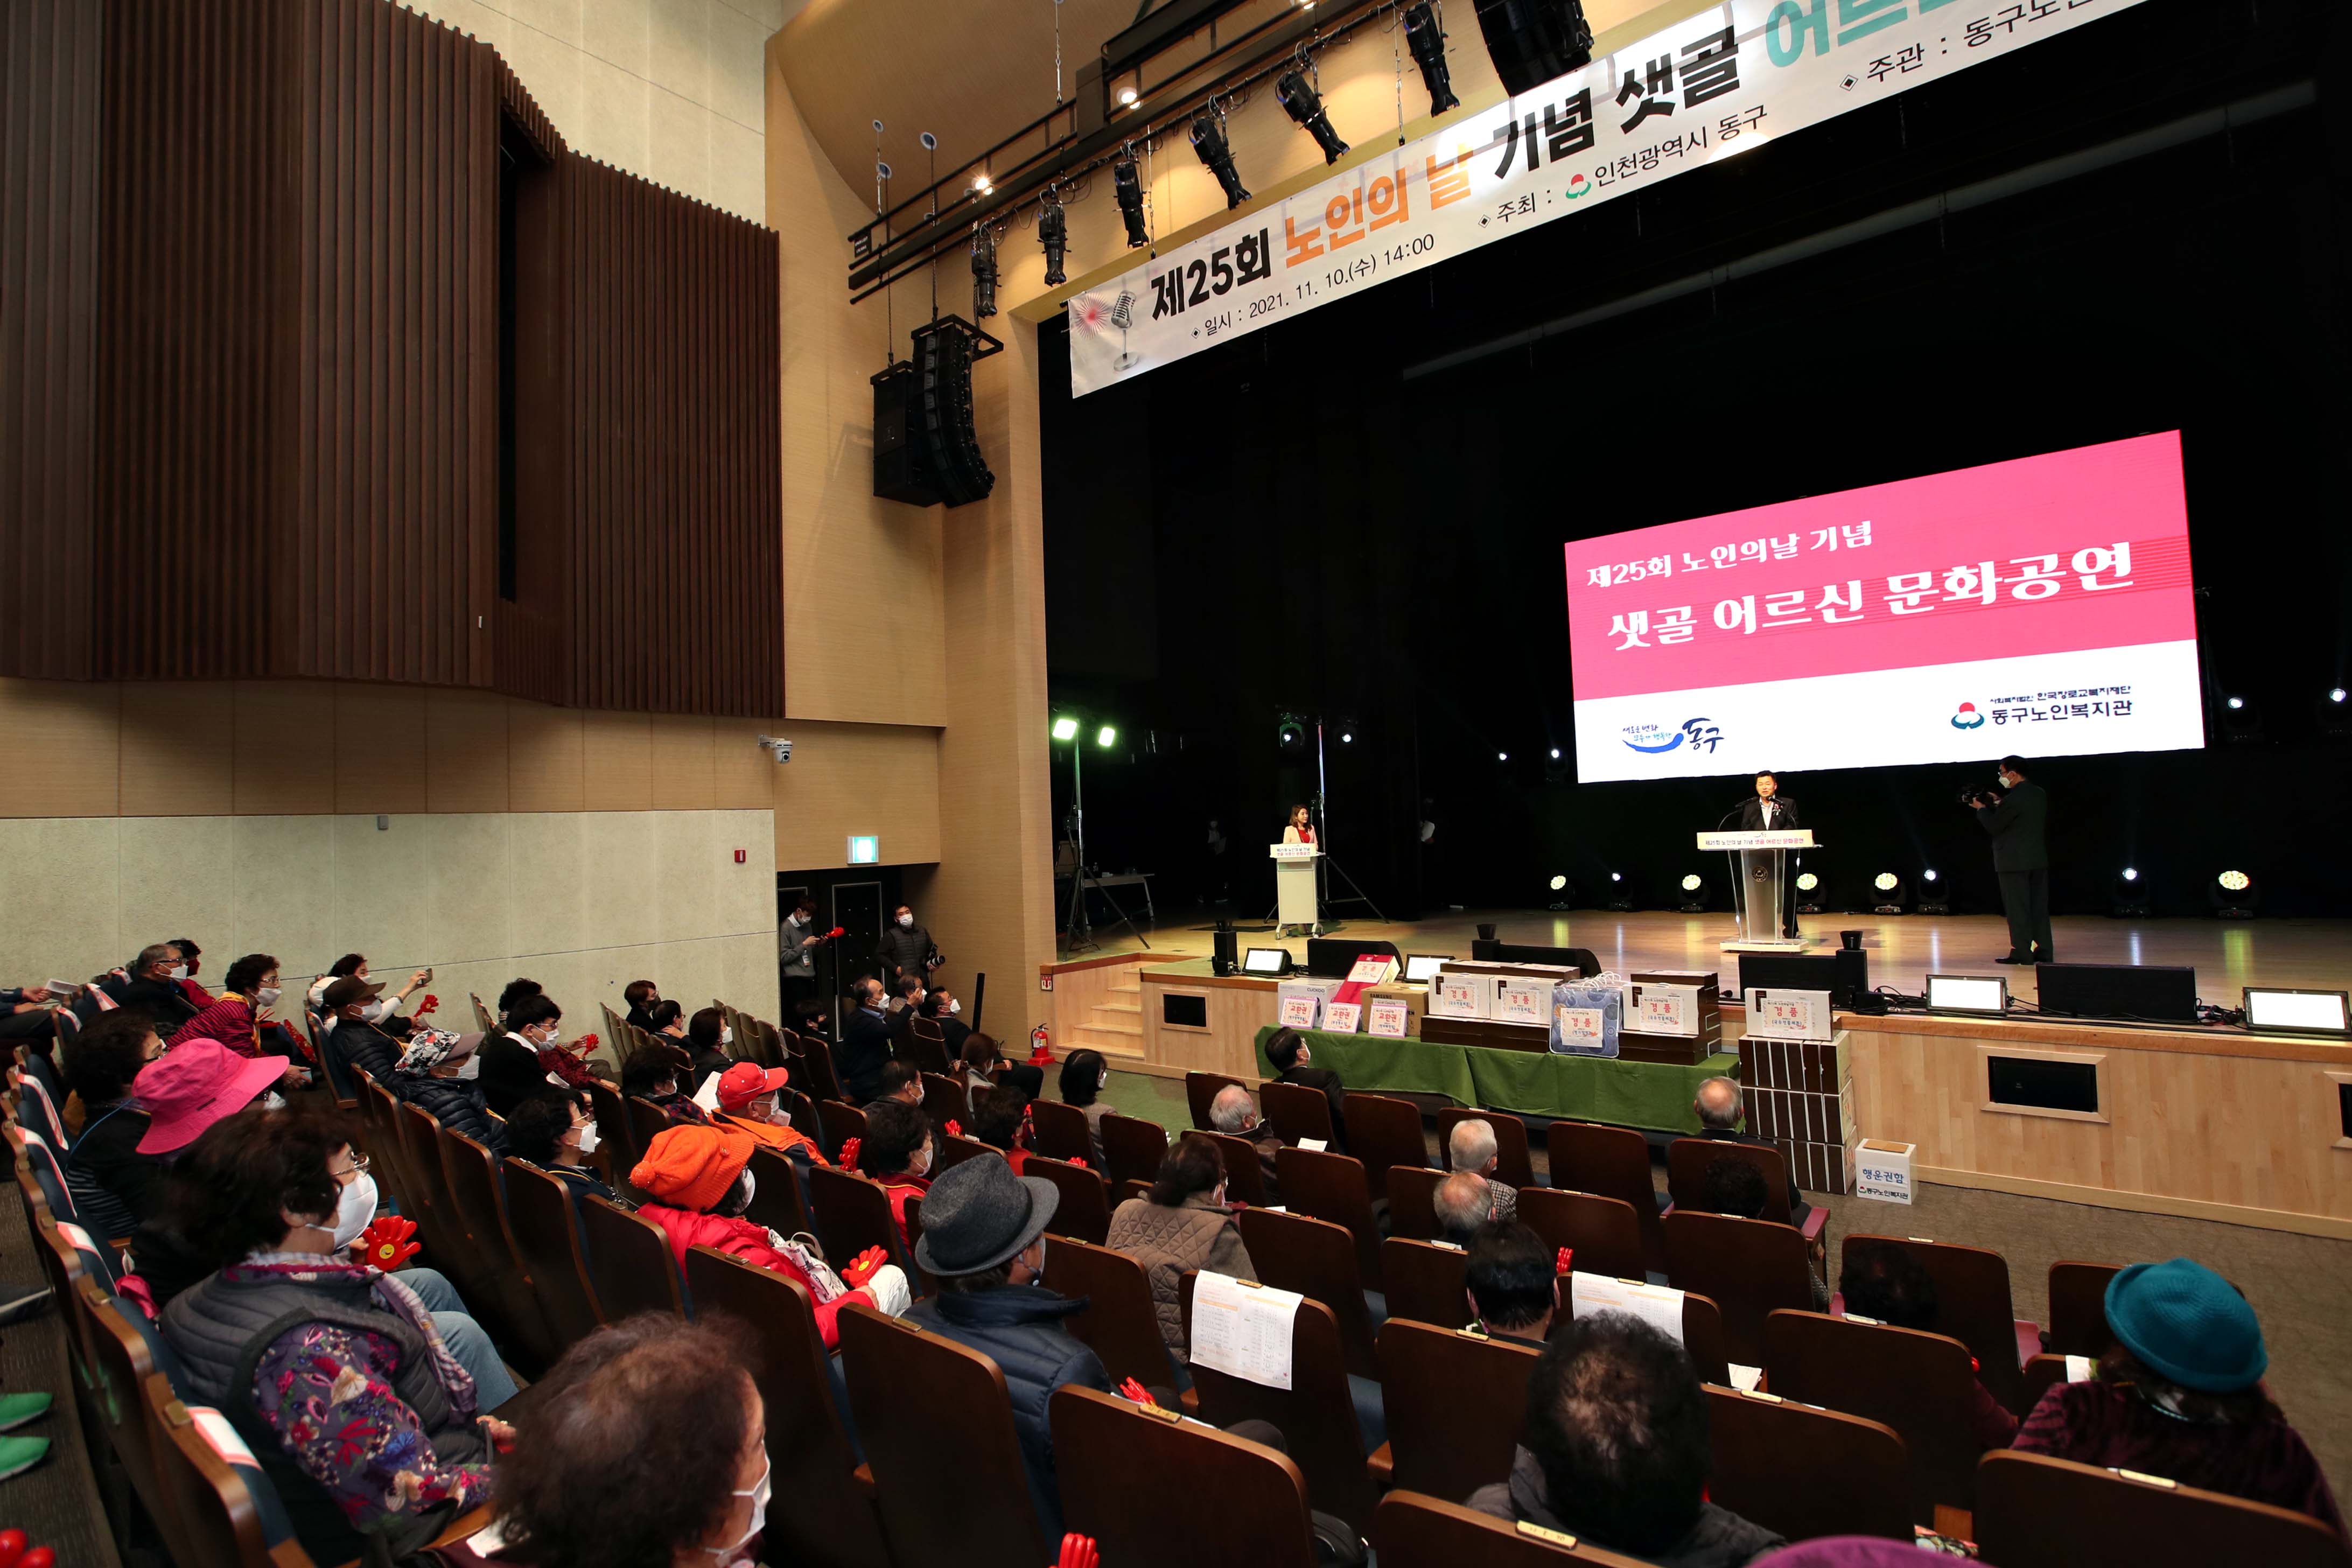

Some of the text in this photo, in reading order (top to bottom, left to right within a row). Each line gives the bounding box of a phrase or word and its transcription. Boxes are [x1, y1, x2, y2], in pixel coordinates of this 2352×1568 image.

[1867, 43, 1925, 82] 주관
[1151, 227, 1271, 321] 제25회
[1285, 166, 1409, 268] 노인의
[1425, 143, 1474, 211] 날
[1493, 86, 1595, 179] 기념
[1615, 25, 1740, 135] 샛골
[1497, 192, 1536, 222] 주최
[1595, 127, 1707, 188] 인천광역시
[1718, 104, 1767, 141] 동구
[1205, 311, 1231, 337] 일시
[1249, 294, 1289, 319] 2021.
[1296, 281, 1318, 299] 11.
[1326, 254, 1376, 288] 10.(수)
[1384, 233, 1434, 271] 14:00
[1586, 520, 1872, 588] 제25회 노인의날 기념
[1607, 541, 2133, 651] 샛골 어르신 문화공연
[2037, 685, 2131, 701] 한국장로교복지재단
[1992, 701, 2132, 725] 동구노인복지관
[1682, 717, 1725, 754] 동구
[1290, 1005, 1307, 1014] 교환권
[1332, 1010, 1350, 1019] 교환권
[1378, 1013, 1397, 1023] 교환권
[1863, 1168, 1904, 1184] 행운권함
[1867, 1187, 1908, 1200] 동구노인복지관
